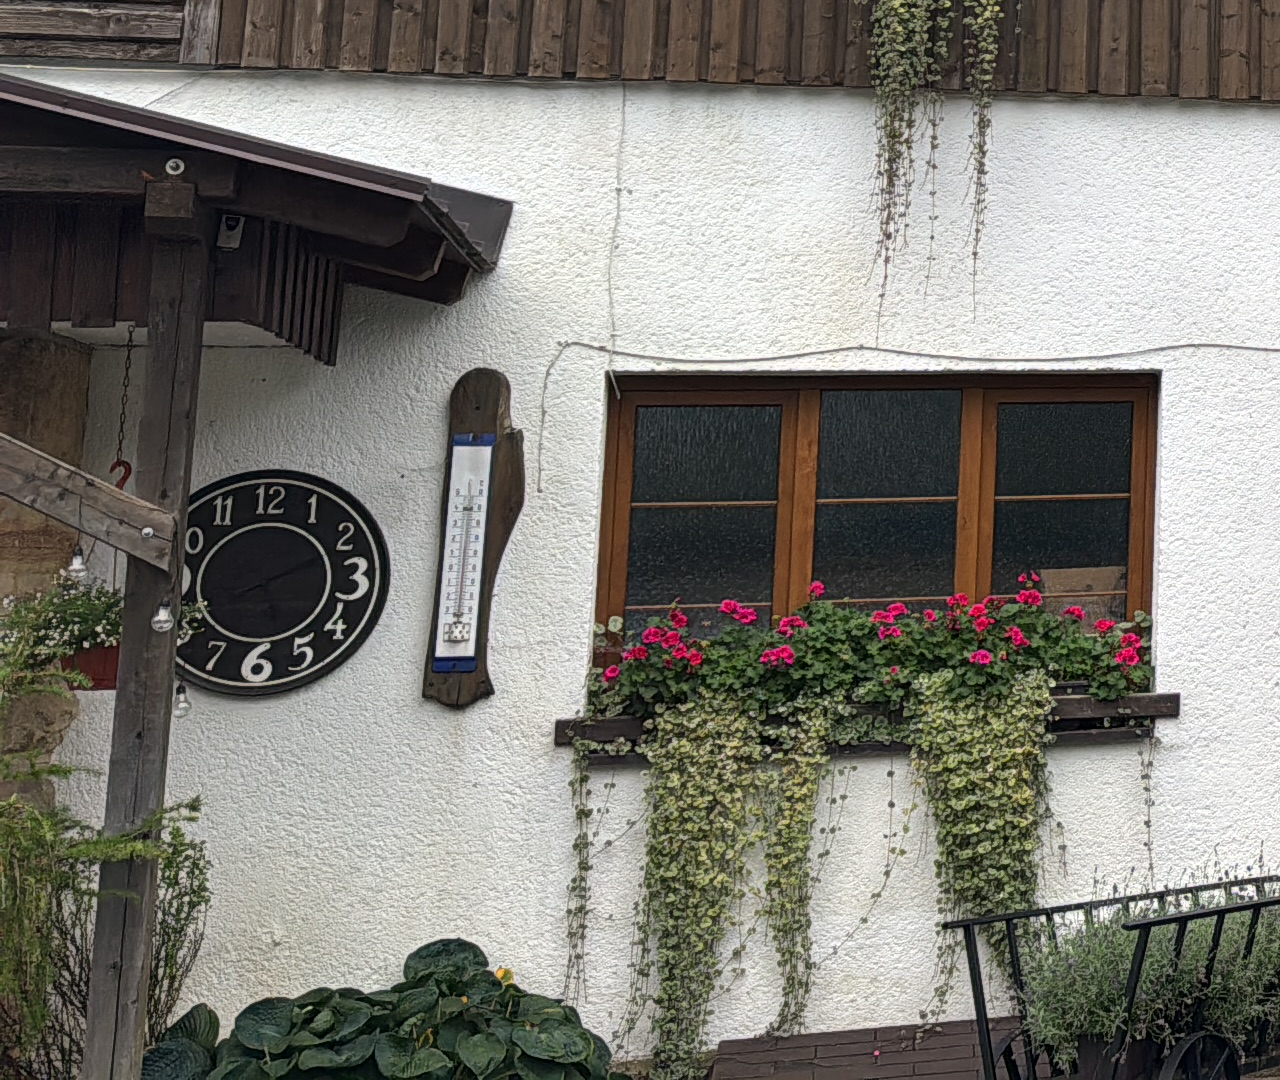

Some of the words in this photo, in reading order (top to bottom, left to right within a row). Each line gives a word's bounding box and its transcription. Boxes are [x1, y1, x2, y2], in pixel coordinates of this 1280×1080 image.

[212, 495, 234, 526] 11
[256, 485, 285, 514] 12
[307, 493, 318, 524] 1
[336, 522, 355, 551] 2
[335, 556, 370, 600] 3
[323, 602, 347, 640] 4
[205, 641, 228, 671] 7
[240, 642, 273, 682] 6
[288, 632, 315, 671] 5
